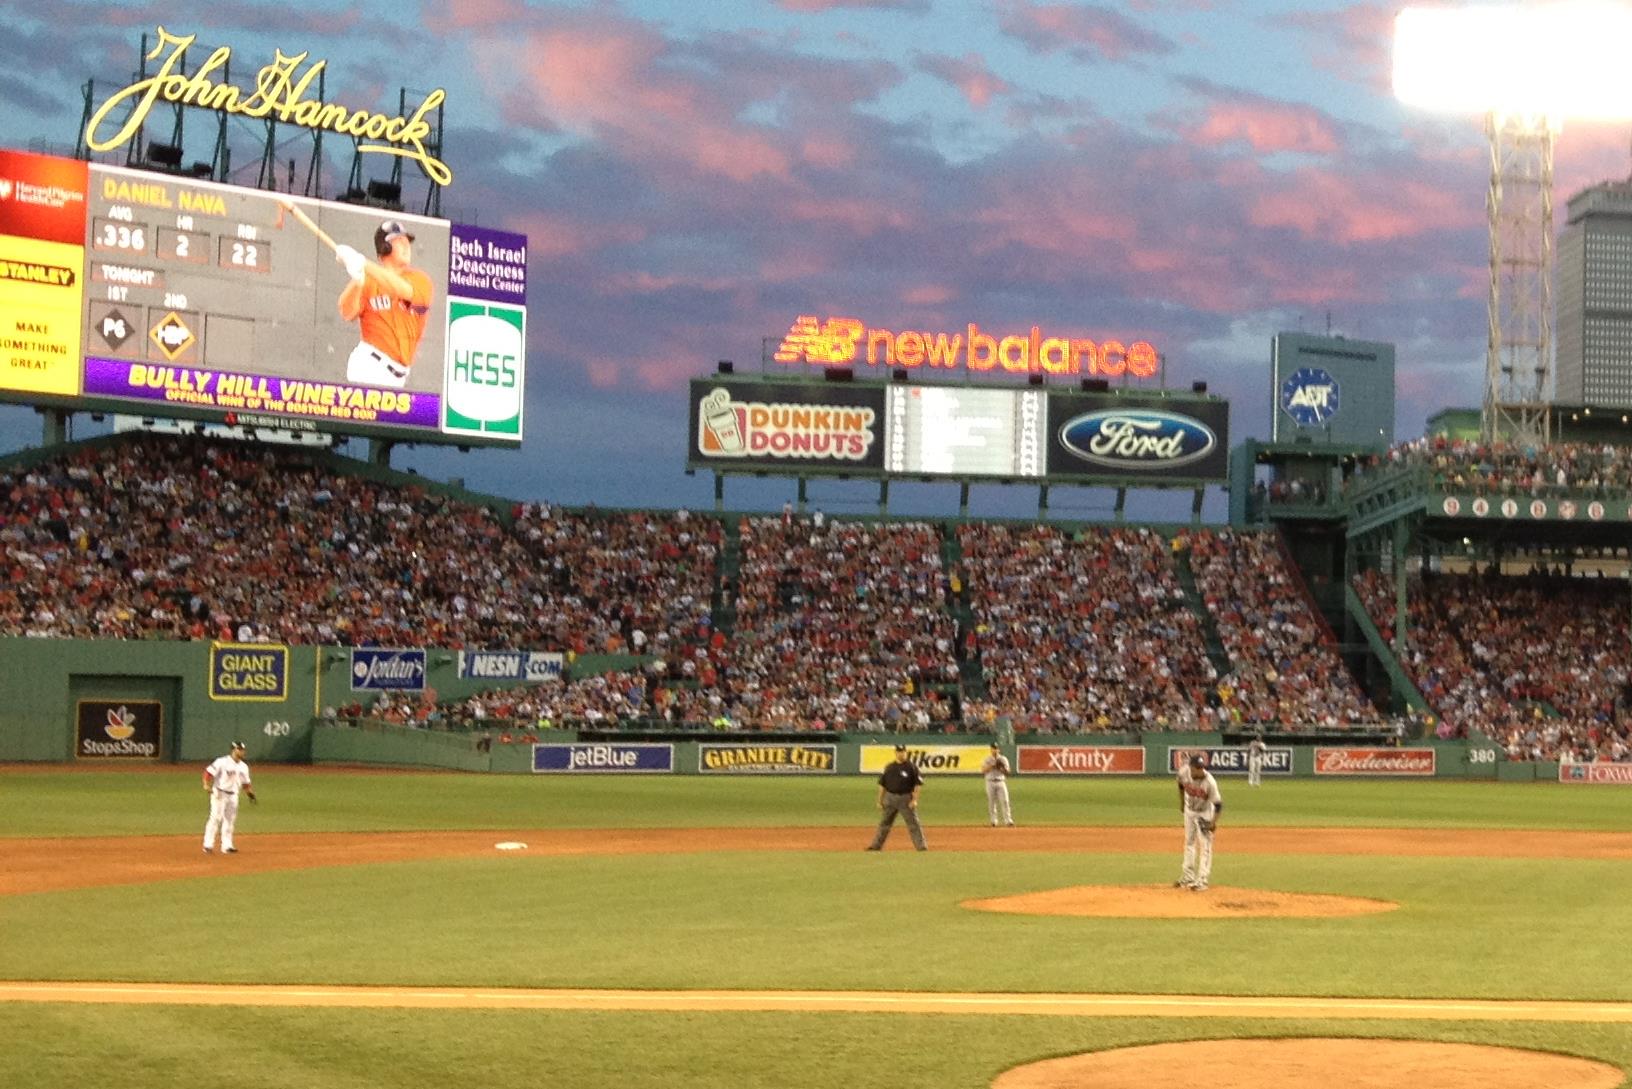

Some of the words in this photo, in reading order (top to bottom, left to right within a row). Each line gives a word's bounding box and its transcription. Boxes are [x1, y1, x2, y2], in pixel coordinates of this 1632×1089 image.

[86, 25, 240, 152] John
[238, 48, 452, 186] Hancock
[103, 177, 172, 209] DANIEL
[178, 190, 227, 216] NAVA
[108, 204, 133, 221] AVG
[176, 215, 194, 231] HR
[96, 224, 145, 250] .336
[237, 224, 257, 241] RBI
[175, 235, 189, 257] 2
[231, 243, 258, 268] 22
[451, 235, 483, 258] Beth
[488, 241, 526, 265] Israel
[101, 264, 155, 286] TONIGHT
[451, 253, 525, 281] Deaconess
[450, 270, 490, 288] Medical
[492, 276, 525, 294] Center
[164, 292, 188, 309] 2ND
[16, 321, 48, 334] MAKE
[0, 339, 67, 354] OMETHING
[866, 327, 960, 369] new
[967, 322, 1158, 377] balance
[10, 358, 47, 370] GREAT
[454, 349, 516, 388] HESS
[128, 363, 212, 393] BULLY
[216, 373, 272, 400] HILL
[279, 379, 411, 414] VINEYARDS
[1288, 384, 1333, 408] ADT
[165, 388, 214, 405] OFFICIAL
[217, 393, 245, 408] WINE
[246, 397, 261, 409] OF
[263, 399, 285, 412] THE
[286, 401, 329, 416] BOSTON
[330, 406, 351, 418] RED
[280, 418, 317, 430] ELECTRIC
[750, 408, 870, 432] DUNKIN'
[750, 431, 864, 455] DONUTS
[1090, 416, 1186, 459] Ford
[221, 653, 276, 672] GIANT
[360, 654, 423, 689] Jordan's
[472, 654, 520, 677] NESN
[219, 671, 278, 691] GLASS
[264, 720, 291, 736] 420
[567, 746, 638, 770] jetBlue
[705, 747, 787, 769] GRANITE
[791, 745, 832, 769] CITY
[1048, 747, 1115, 772] xfinity
[1210, 751, 1240, 768] ACE
[1241, 751, 1290, 768] TKET
[1318, 749, 1432, 773] Budweiser
[1469, 749, 1496, 764] 380
